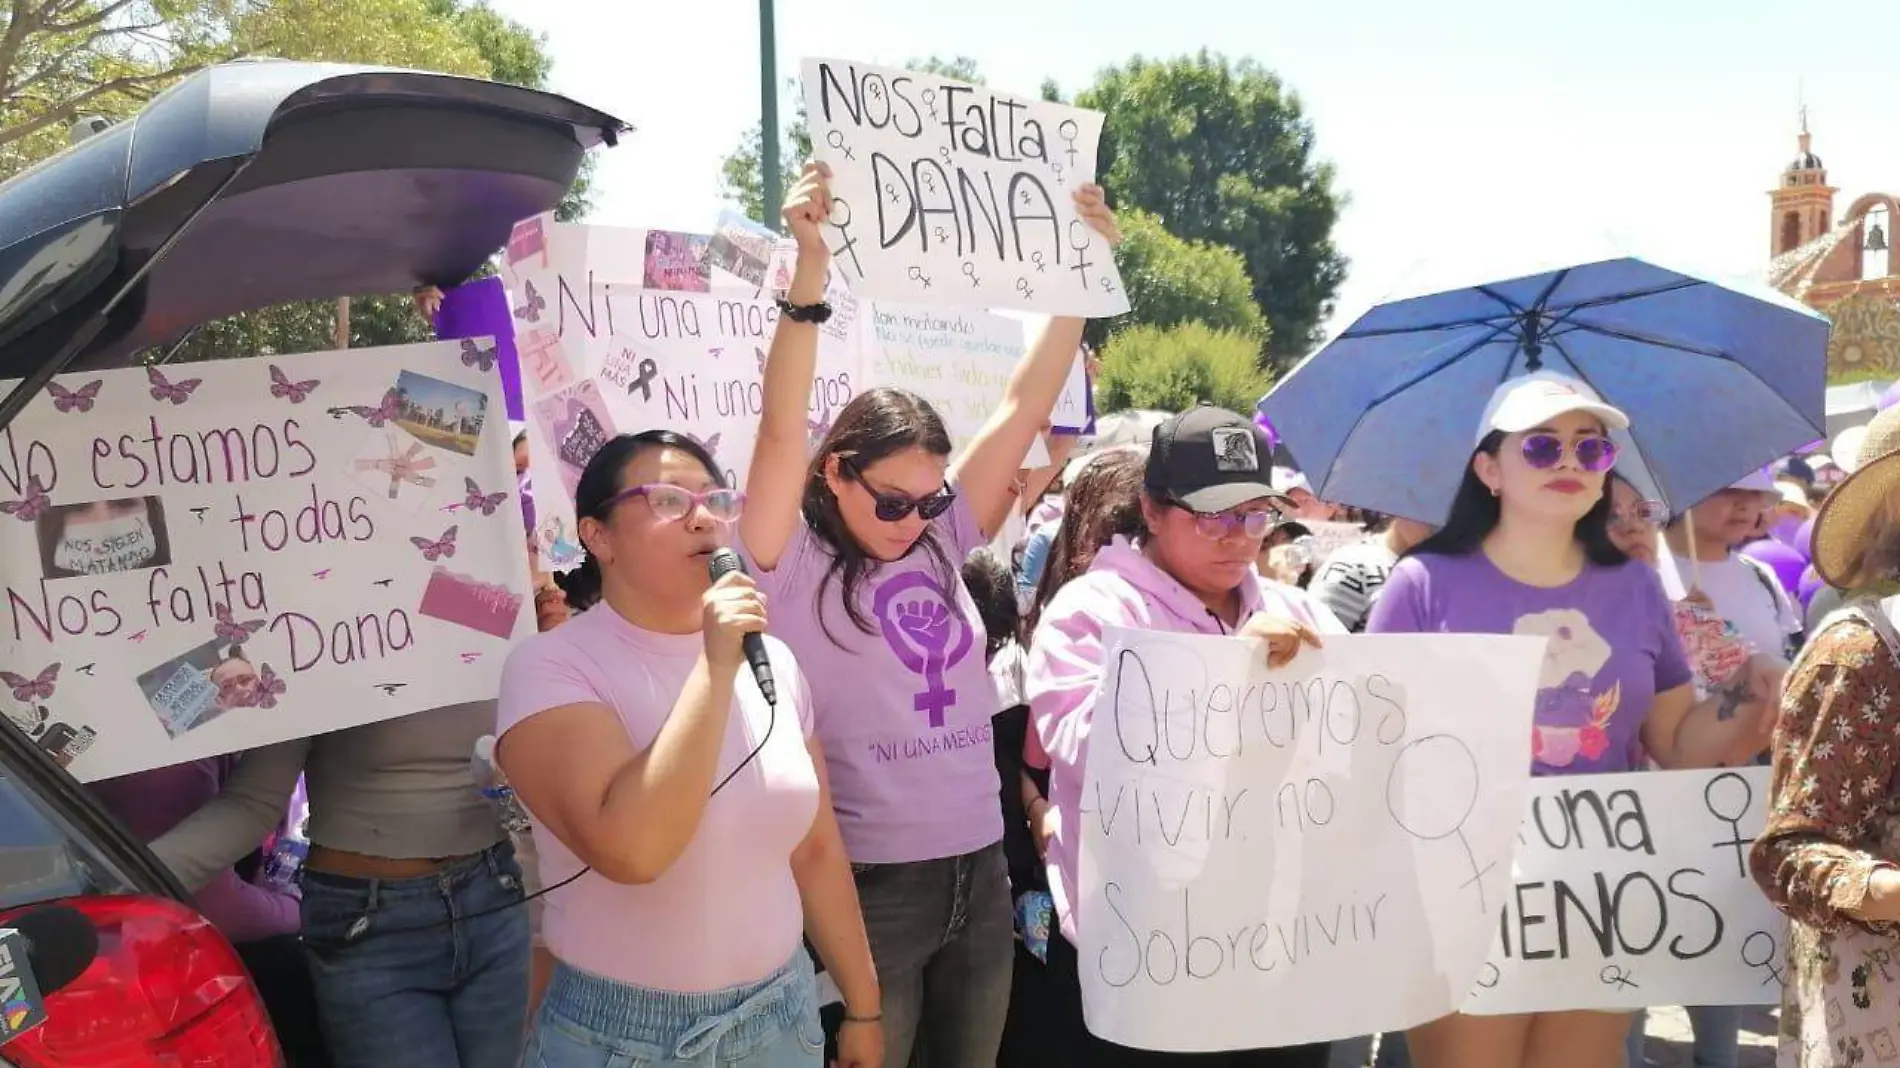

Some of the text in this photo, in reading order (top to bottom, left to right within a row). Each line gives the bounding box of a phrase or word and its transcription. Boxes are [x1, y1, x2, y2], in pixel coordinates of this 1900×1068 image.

[818, 62, 922, 138] NOS
[871, 152, 1061, 265] DANA
[557, 269, 614, 337] Ni
[639, 295, 701, 339] una
[664, 373, 700, 420] Ni
[92, 415, 316, 489] estamos
[64, 538, 92, 553] NOS
[230, 484, 374, 552] todas
[6, 561, 268, 643] Nos falta
[267, 608, 414, 672] Dana
[1114, 648, 1407, 765] Queremos
[904, 735, 942, 759] UNA
[1277, 777, 1335, 833] no
[1532, 788, 1657, 856] una
[1099, 881, 1388, 988] Sobrevivir
[1500, 867, 1724, 960] ENOS
